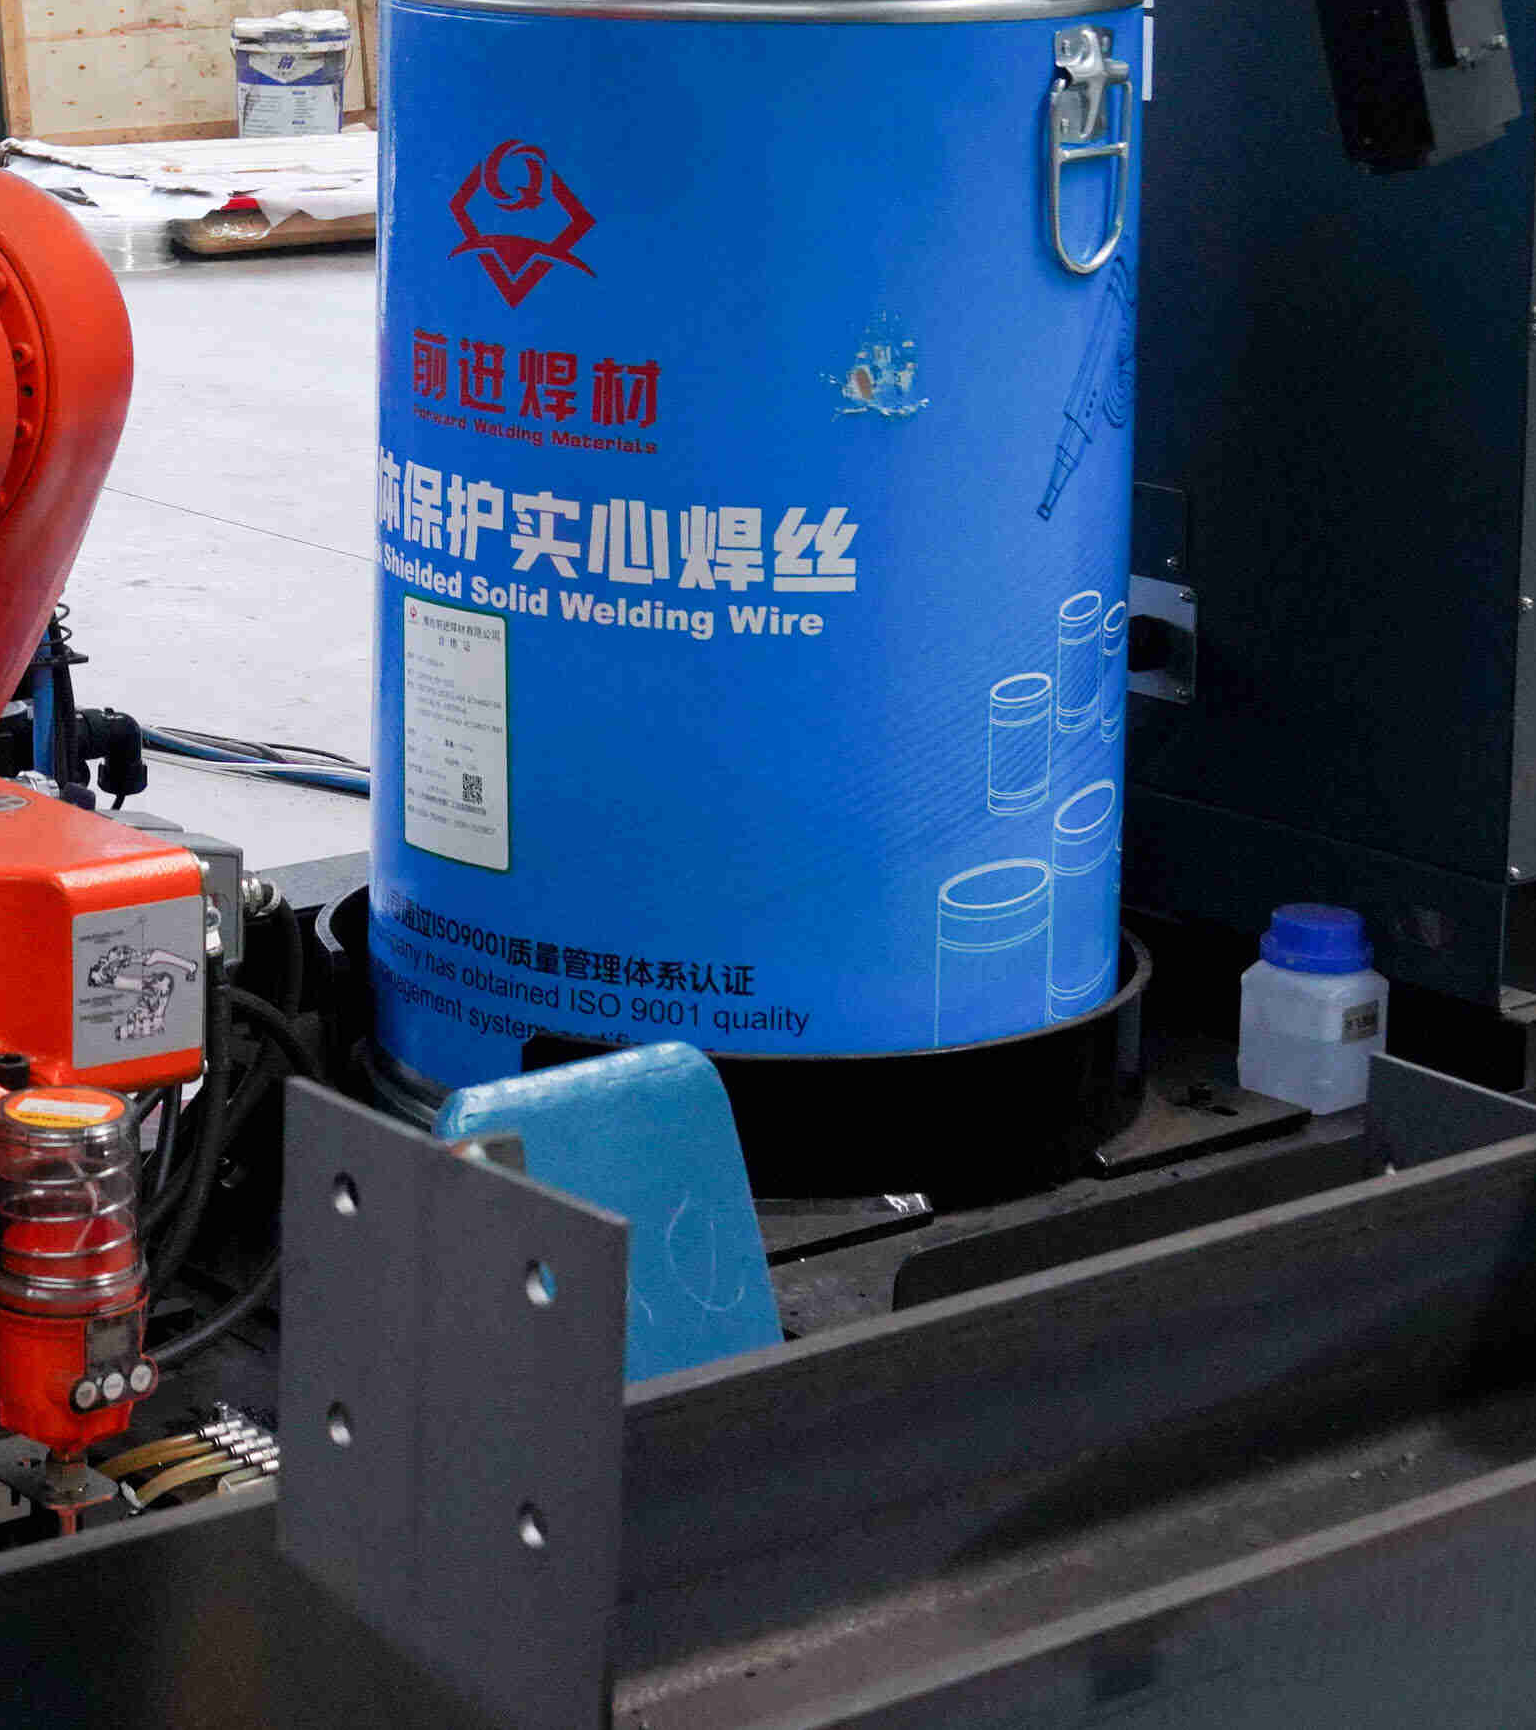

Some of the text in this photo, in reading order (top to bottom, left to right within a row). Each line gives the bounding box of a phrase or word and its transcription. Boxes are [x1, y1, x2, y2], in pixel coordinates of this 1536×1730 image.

[413, 327, 662, 429] 前进焊材
[551, 429, 658, 454] Materials
[383, 542, 462, 599] Shielded
[471, 576, 549, 616] Solid
[559, 590, 715, 640] Welding
[728, 605, 824, 636] Wire
[425, 948, 456, 981] has
[462, 964, 560, 1010] obtained
[569, 988, 622, 1018] ISO
[631, 997, 702, 1027] 9001
[713, 1005, 811, 1038] quality
